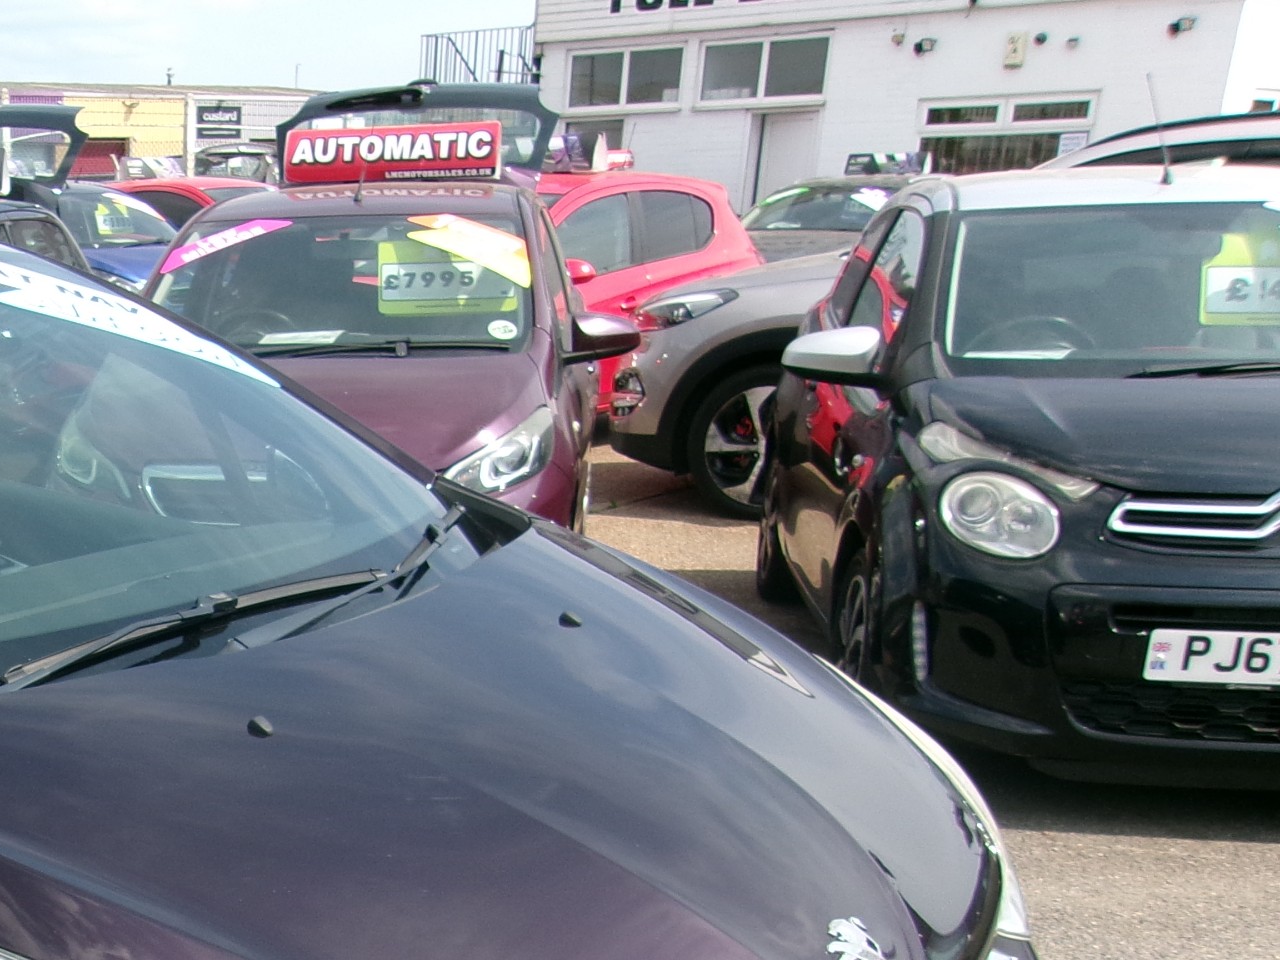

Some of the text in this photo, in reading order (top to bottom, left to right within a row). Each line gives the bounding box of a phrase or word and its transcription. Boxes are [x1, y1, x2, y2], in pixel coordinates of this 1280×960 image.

[290, 130, 493, 165] AUTOMATIC
[383, 270, 475, 291] £7995
[1181, 635, 1280, 674] PJ6
